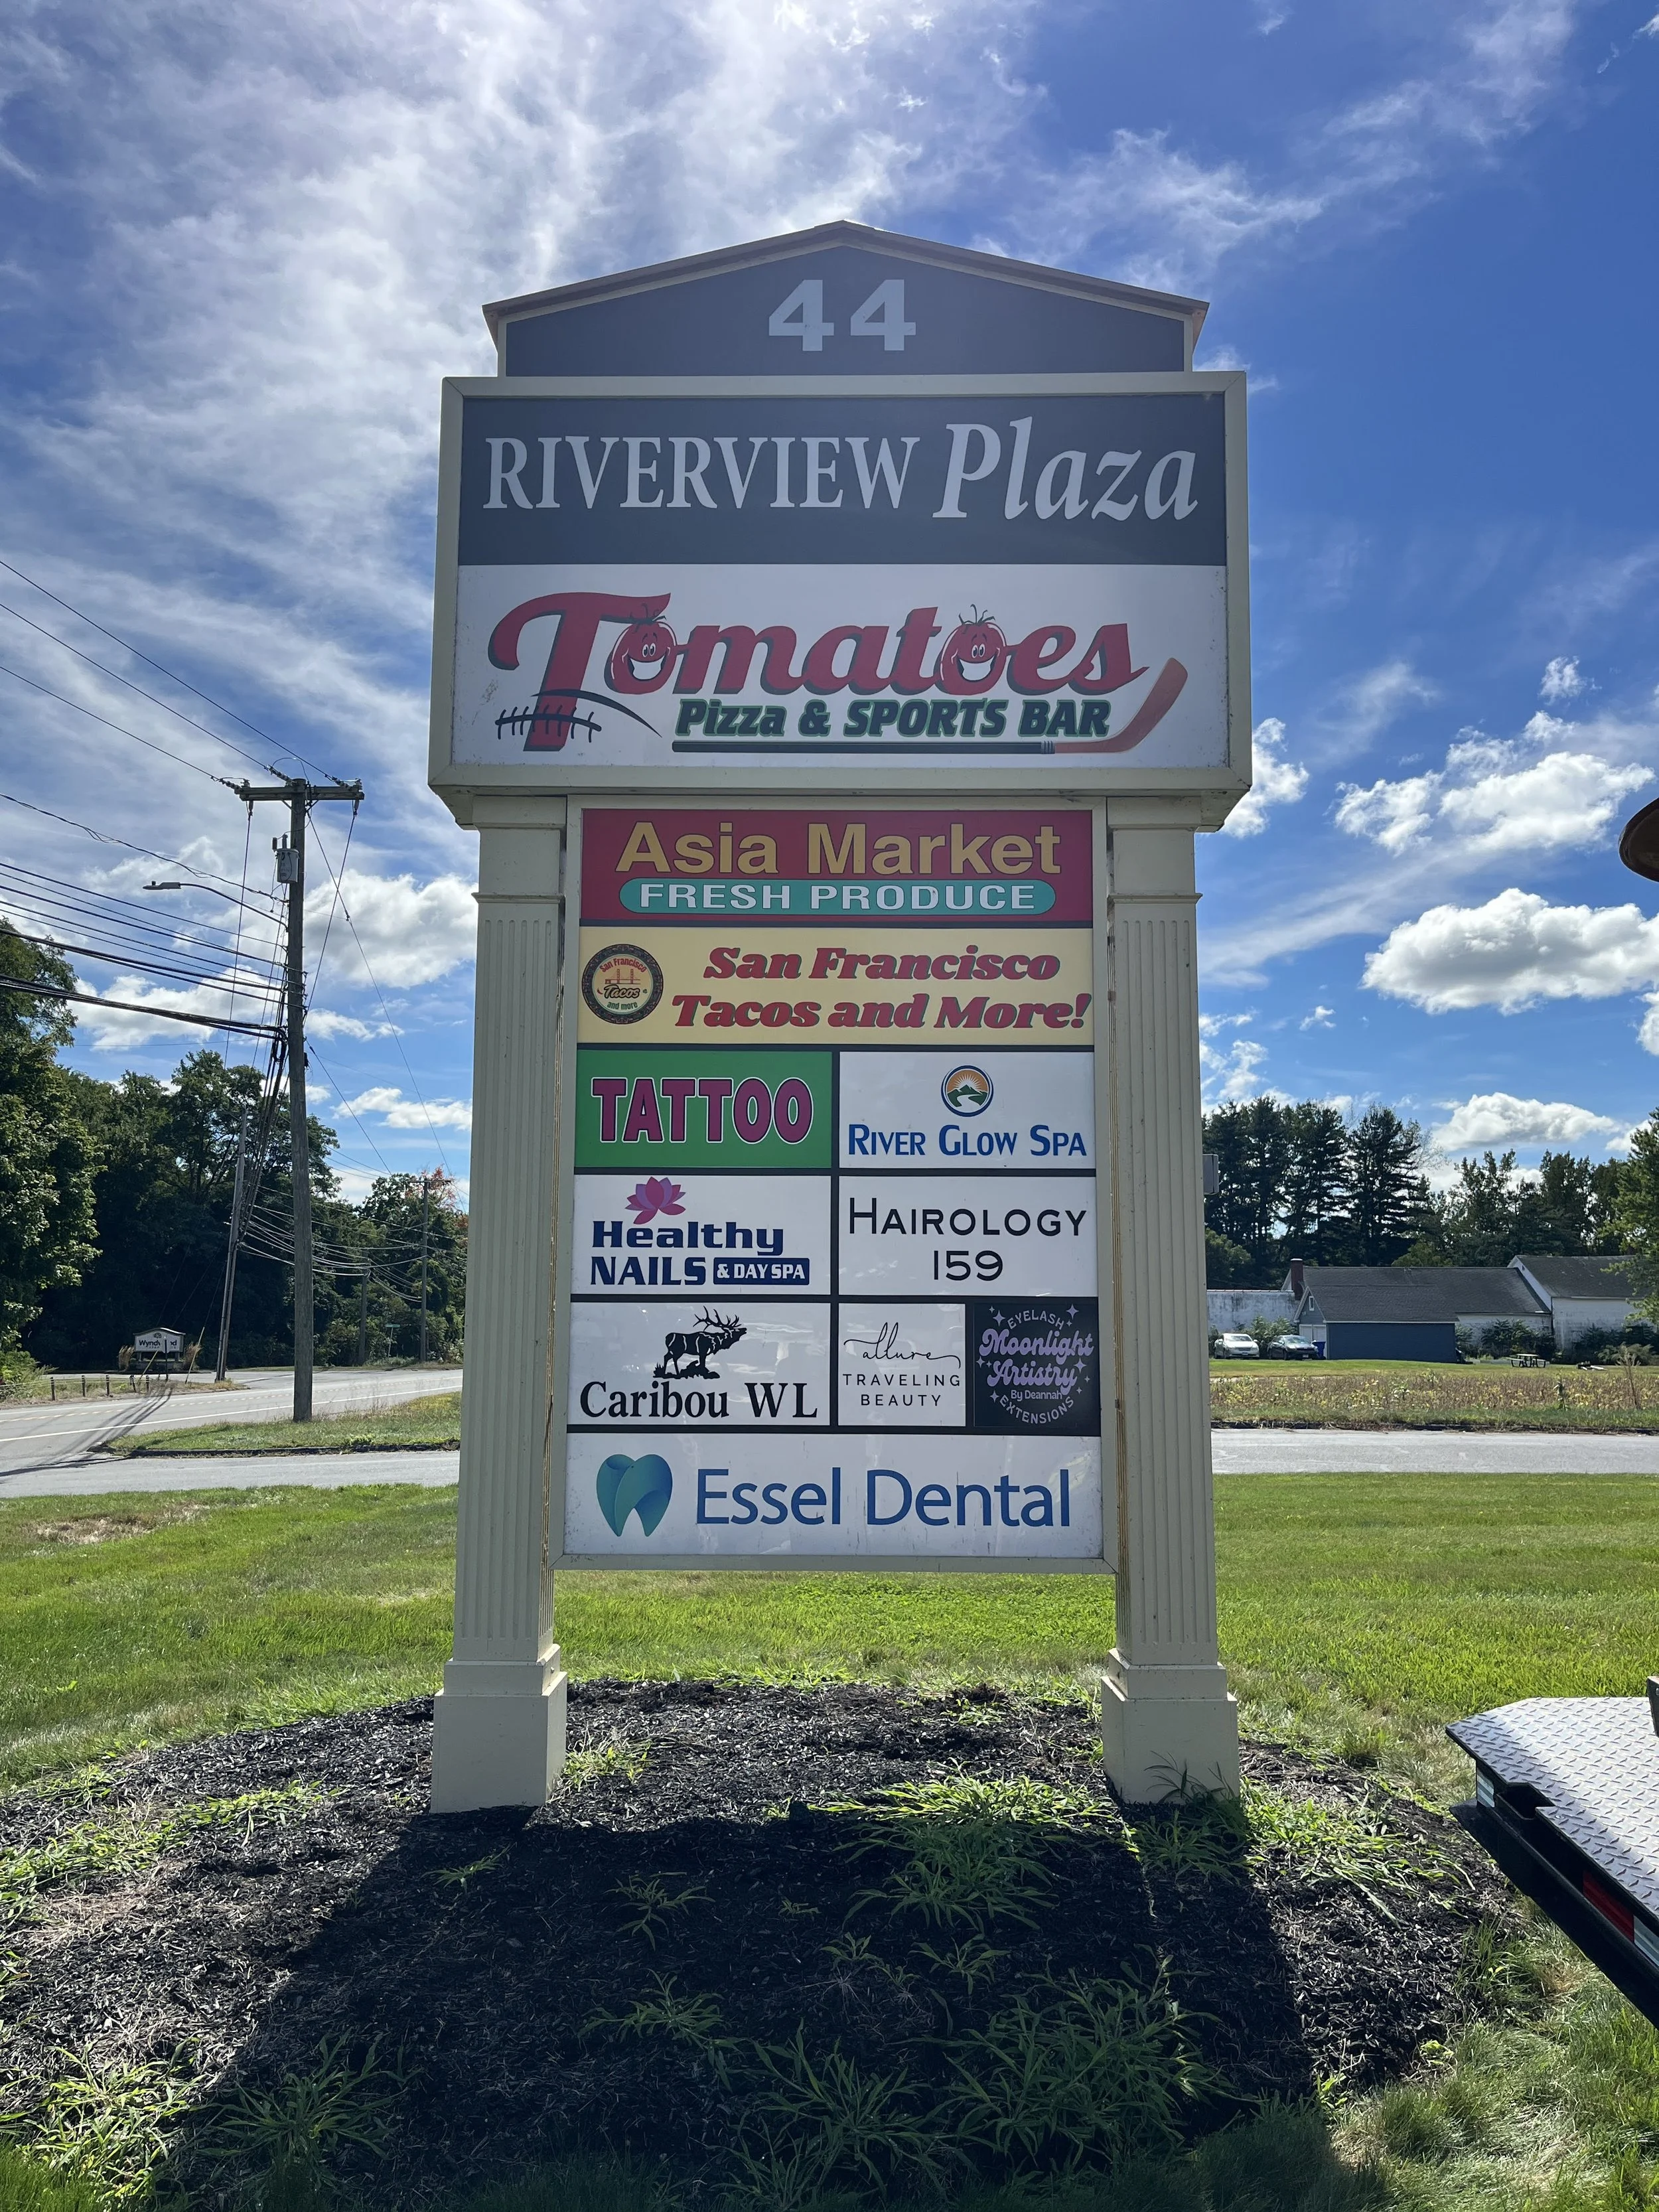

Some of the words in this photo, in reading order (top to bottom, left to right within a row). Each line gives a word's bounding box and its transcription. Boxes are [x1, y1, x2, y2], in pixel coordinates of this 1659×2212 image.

[769, 279, 916, 351] 44
[482, 436, 920, 510] RIVERVIEW
[932, 416, 1198, 521] Plaza
[488, 593, 1149, 751] Tomatoes
[676, 698, 788, 737] Pizza
[798, 699, 831, 737] &
[843, 698, 1009, 737] SPORTS
[1018, 699, 1112, 737] BAR
[615, 822, 779, 875] Asia
[808, 822, 1062, 875] Market
[640, 883, 790, 909] FRESH
[810, 884, 1035, 910] PRODUCE
[599, 962, 614, 973] San
[613, 958, 647, 973] Francisco
[703, 947, 802, 980] San
[808, 945, 1060, 980] Francisco
[603, 984, 640, 999] Tacos
[607, 1001, 620, 1010] and
[620, 1001, 638, 1010] more
[672, 994, 822, 1028] Tacos
[828, 993, 930, 1029] and
[933, 993, 1092, 1029] More!
[591, 1077, 814, 1145] TATTOO
[592, 1220, 784, 1256] Healthy
[591, 1256, 707, 1286] NAILS
[717, 1264, 730, 1279] &
[734, 1264, 768, 1279] DAY
[771, 1264, 806, 1280] SPA
[933, 1250, 1003, 1282] 159
[1007, 1309, 1064, 1330] EYELASH
[843, 1321, 961, 1369] allure
[979, 1328, 1094, 1365] Moonlight
[842, 1374, 960, 1386] TRAVELING
[987, 1358, 1078, 1395] Artistry
[580, 1380, 730, 1418] Caribou
[745, 1382, 818, 1418] WL
[861, 1394, 941, 1406] BEAUTY
[999, 1394, 1074, 1424] EXTENSIONS
[1011, 1389, 1023, 1402] By
[1025, 1390, 1062, 1400] Deannah
[697, 1467, 841, 1525] Essel
[867, 1469, 1070, 1527] Dental
